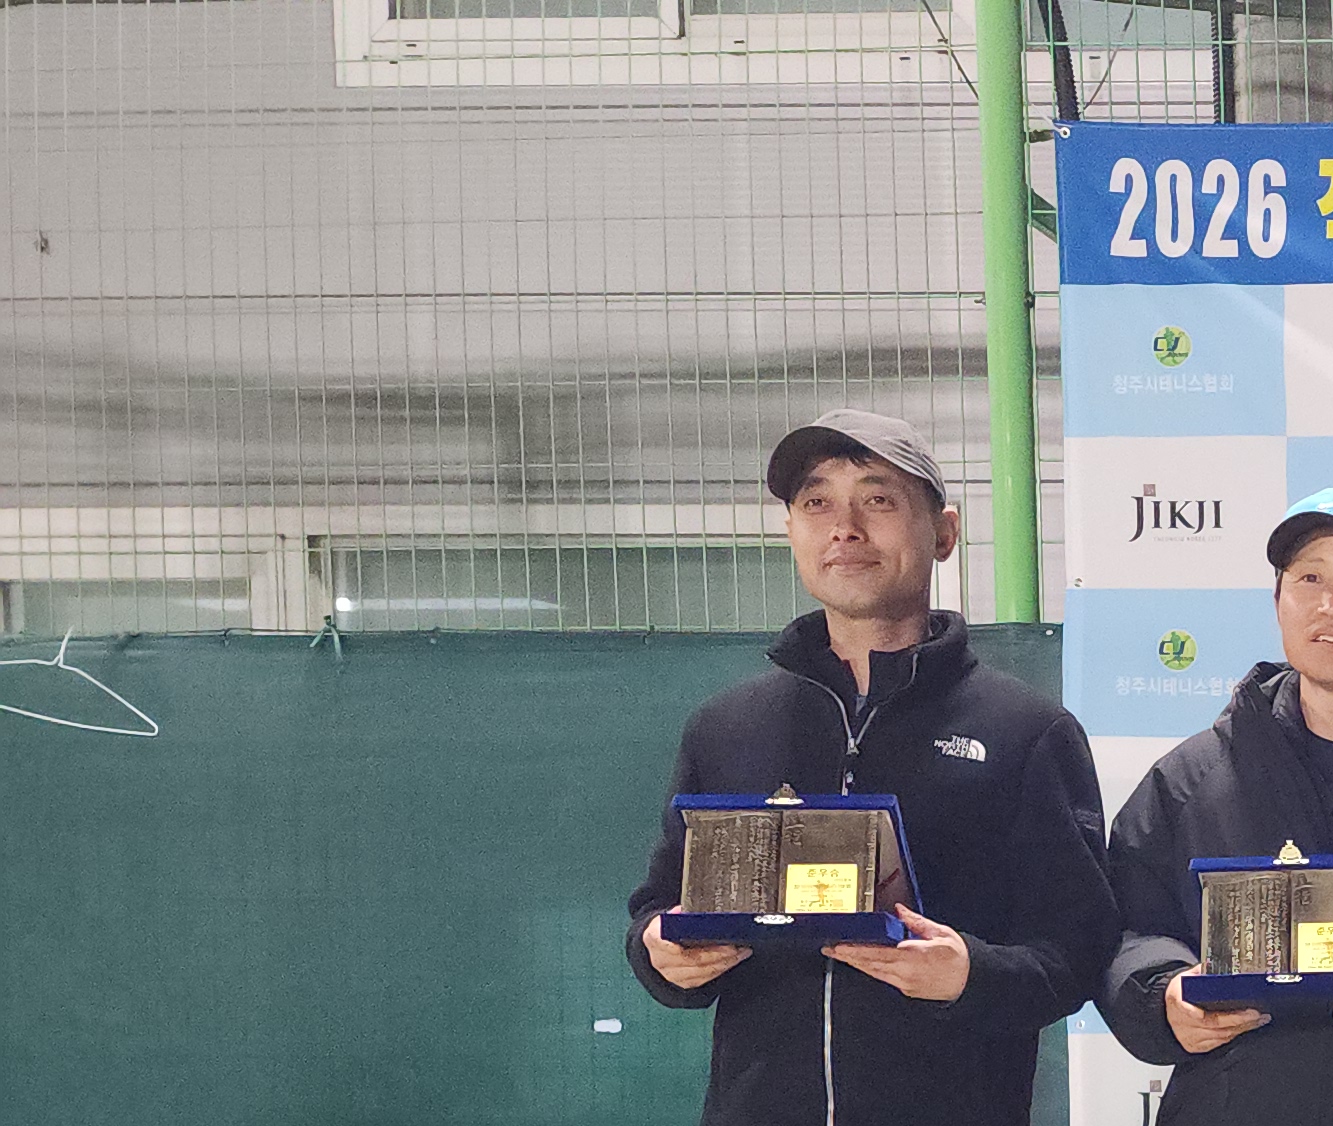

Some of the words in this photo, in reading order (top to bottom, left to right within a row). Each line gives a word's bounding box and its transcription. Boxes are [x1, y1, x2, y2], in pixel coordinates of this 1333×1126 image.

[1109, 157, 1287, 258] 2026
[1112, 374, 1233, 395] 청주시테니스협회
[1129, 495, 1223, 542] JIKJI
